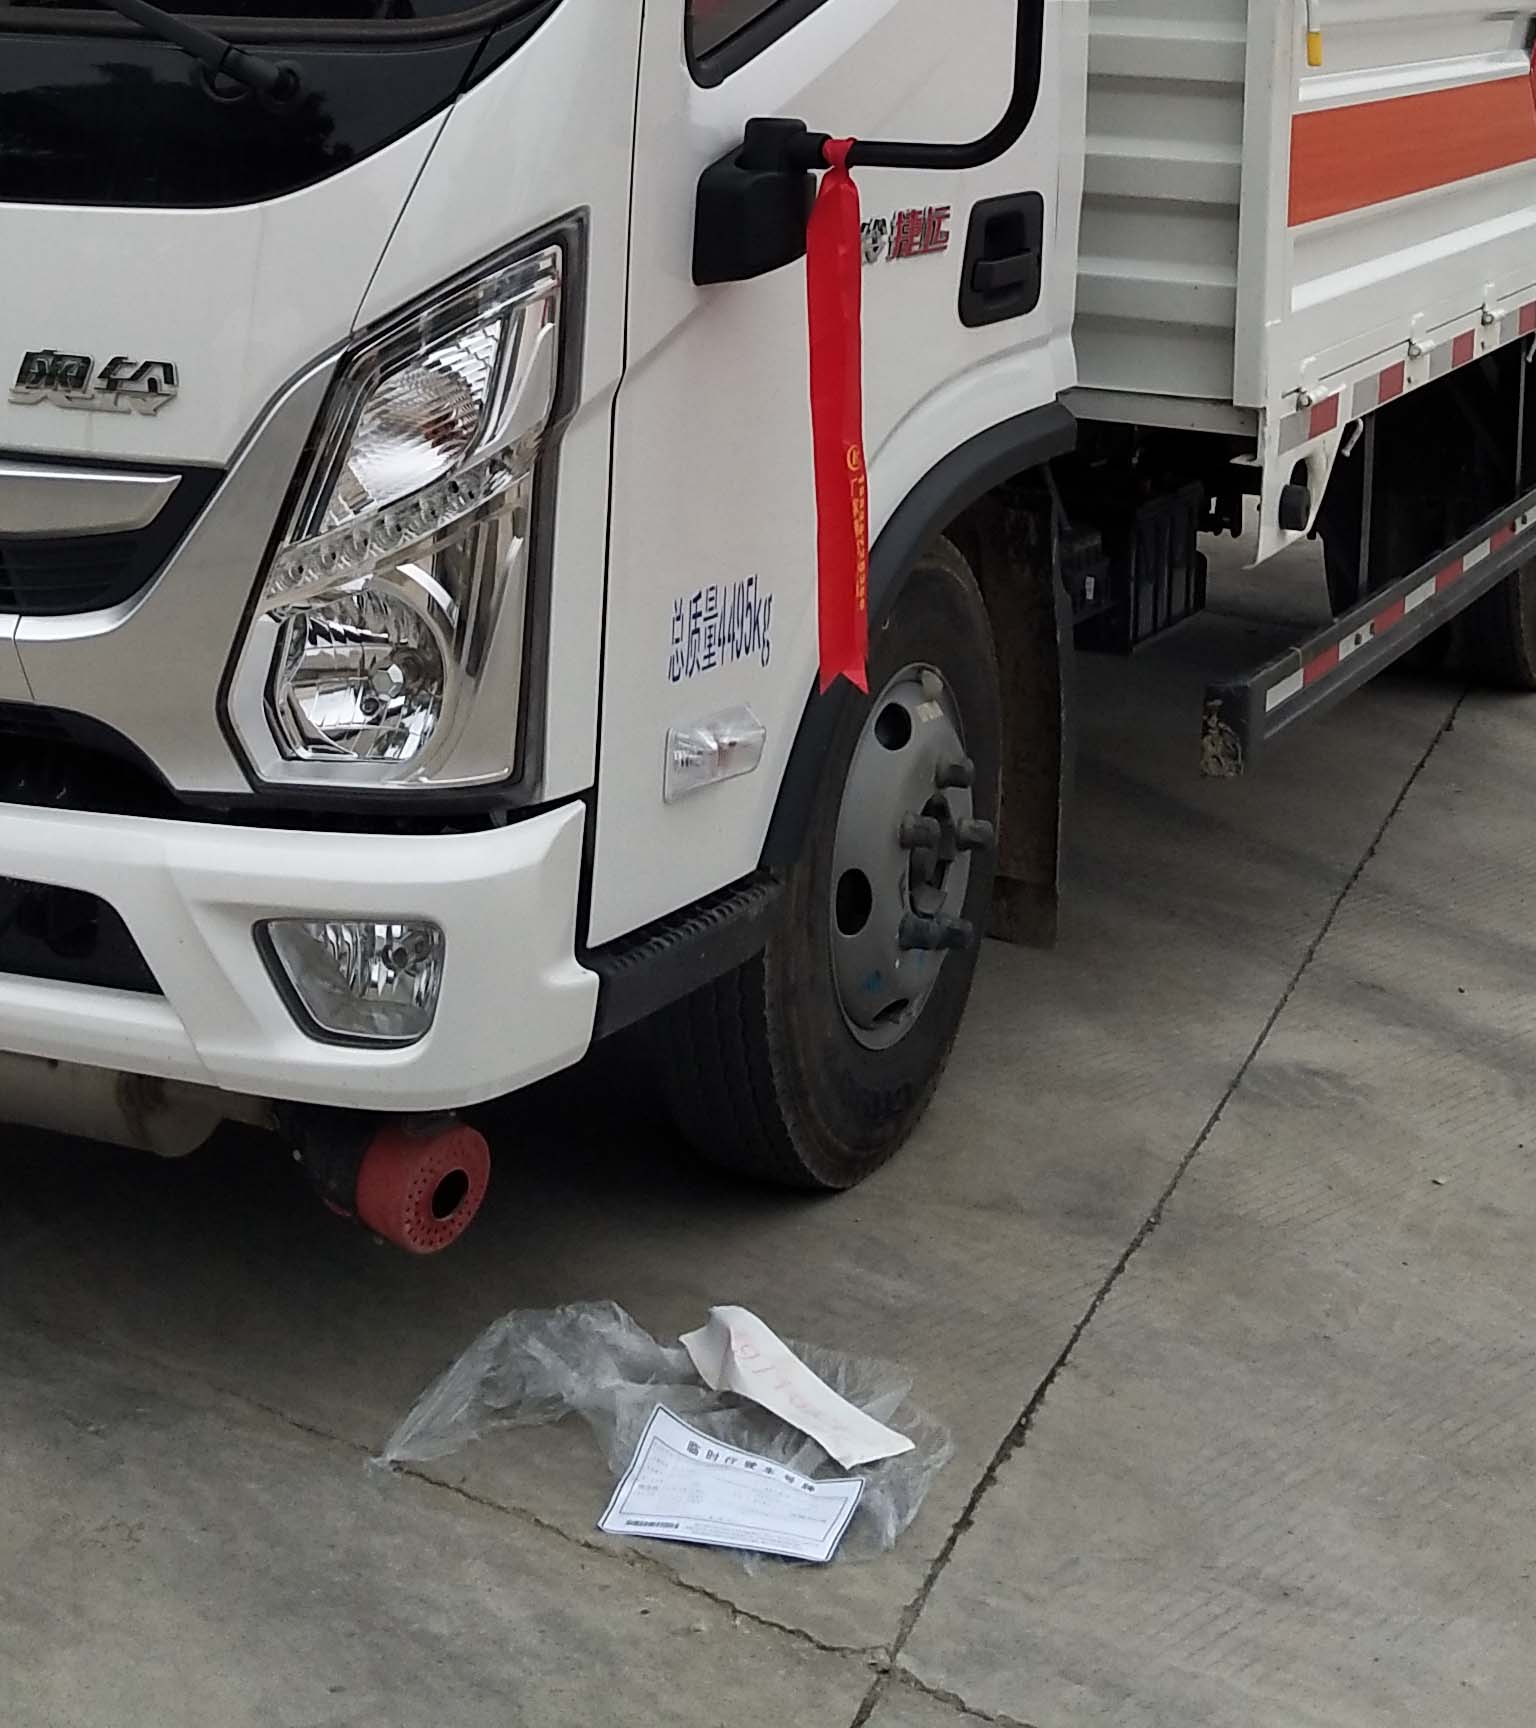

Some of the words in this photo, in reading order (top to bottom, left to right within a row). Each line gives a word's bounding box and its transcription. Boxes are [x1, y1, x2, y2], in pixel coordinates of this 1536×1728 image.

[8, 349, 180, 416] 奥铃
[668, 574, 773, 683] 总质量4495kg
